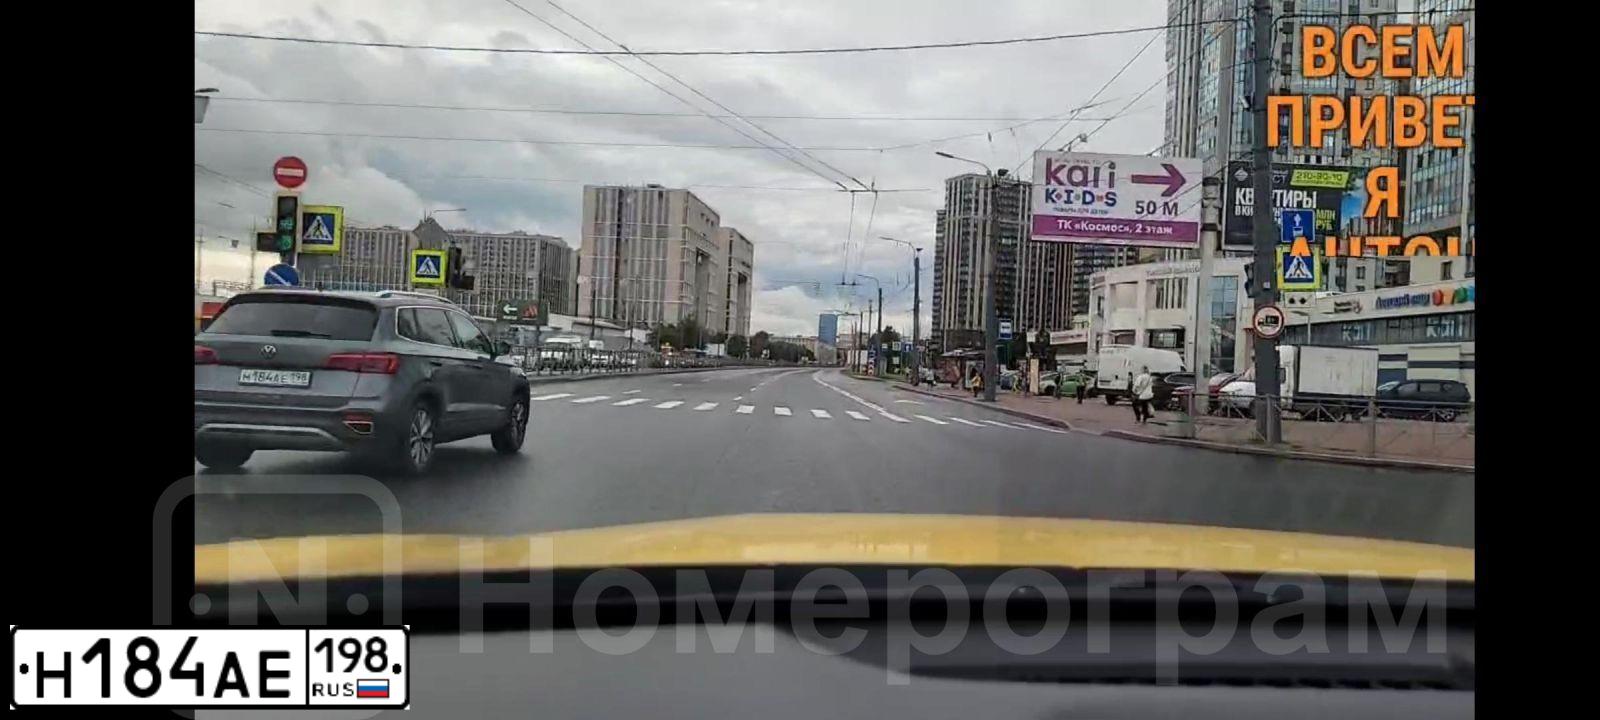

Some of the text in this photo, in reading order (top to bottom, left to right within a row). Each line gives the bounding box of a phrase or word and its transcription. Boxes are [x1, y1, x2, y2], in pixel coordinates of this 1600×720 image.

[1045, 158, 1116, 188] kari
[1235, 188, 1317, 208] КВТИРЫ
[1135, 200, 1157, 215] 50
[1057, 219, 1073, 230] ТК
[1135, 223, 1143, 233] 2
[1145, 226, 1173, 235] этаж
